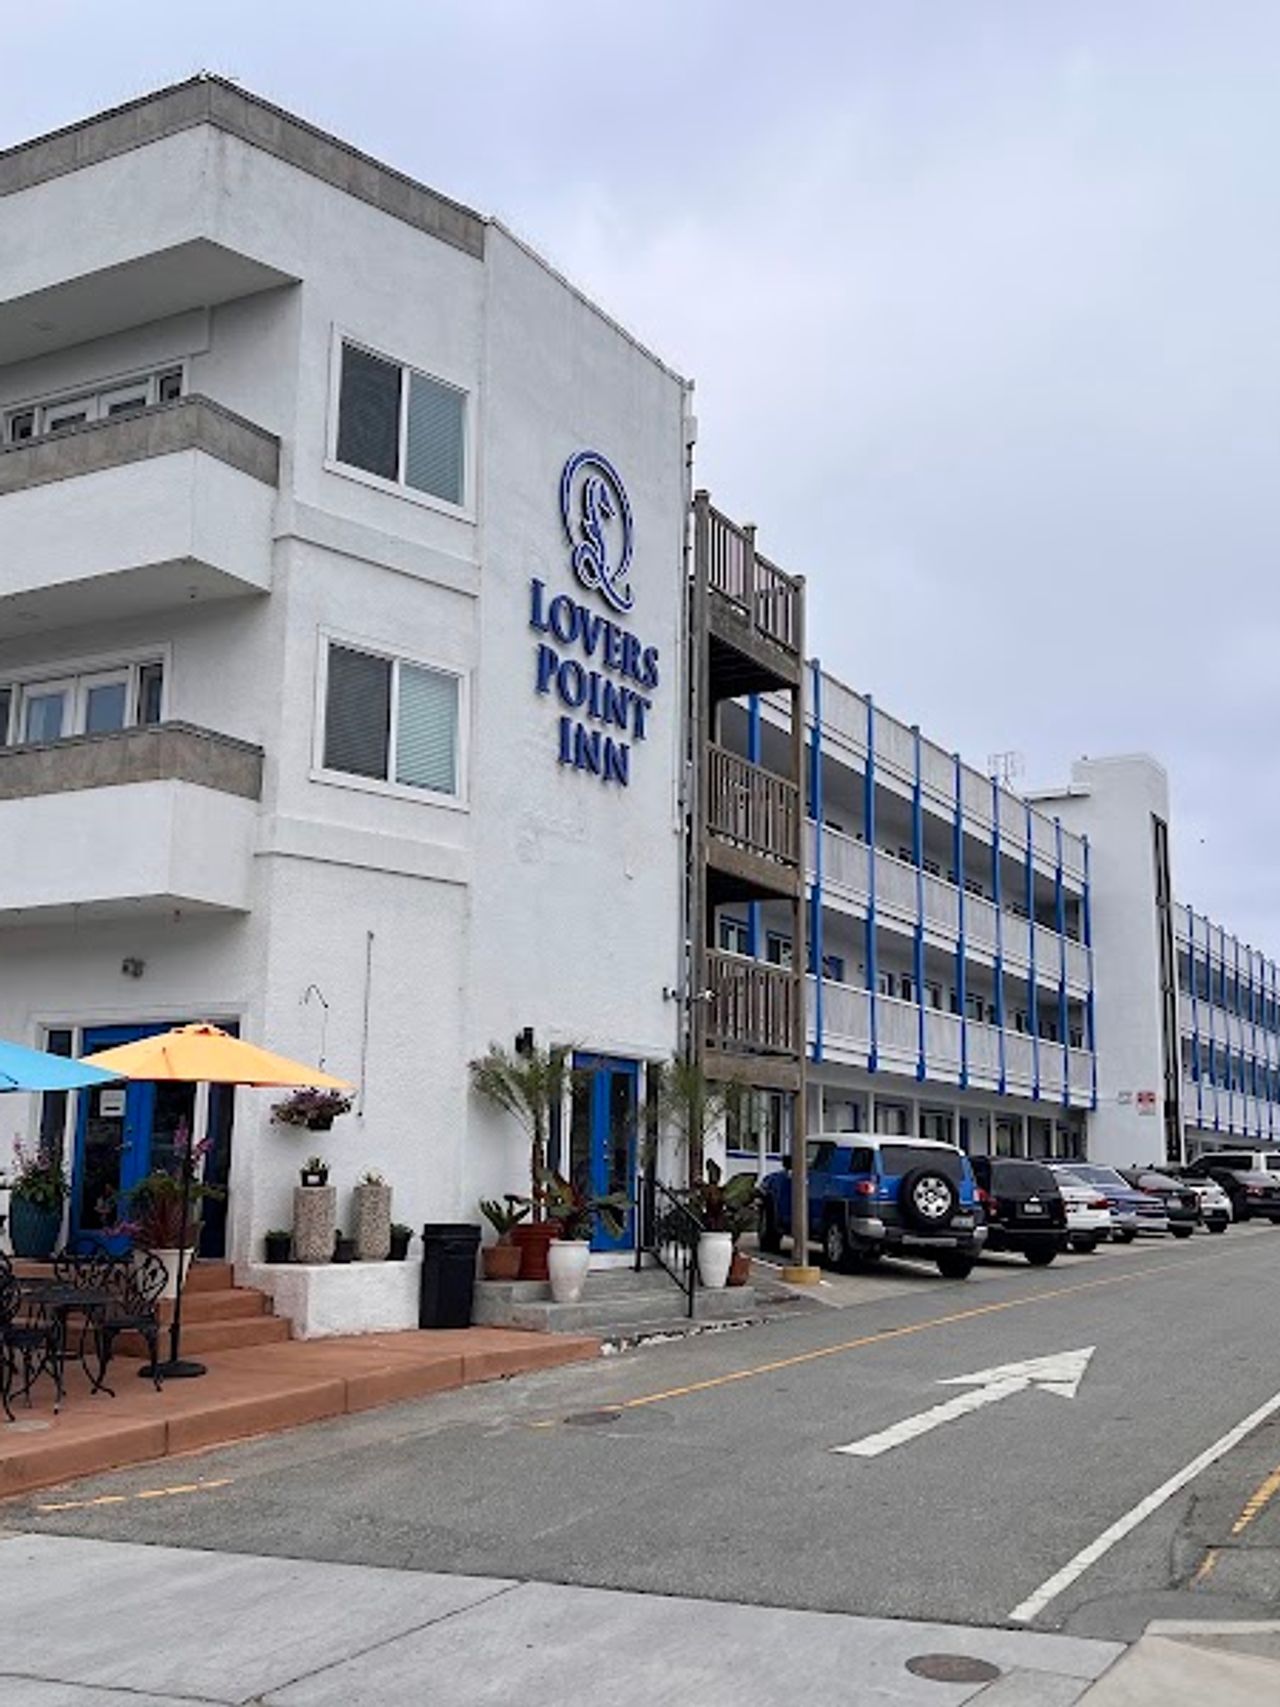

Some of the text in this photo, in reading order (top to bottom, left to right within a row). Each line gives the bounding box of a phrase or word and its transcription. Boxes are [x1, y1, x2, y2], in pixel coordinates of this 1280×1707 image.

[530, 578, 659, 689] LOVERS
[536, 643, 652, 740] POINT
[558, 717, 631, 786] INN
